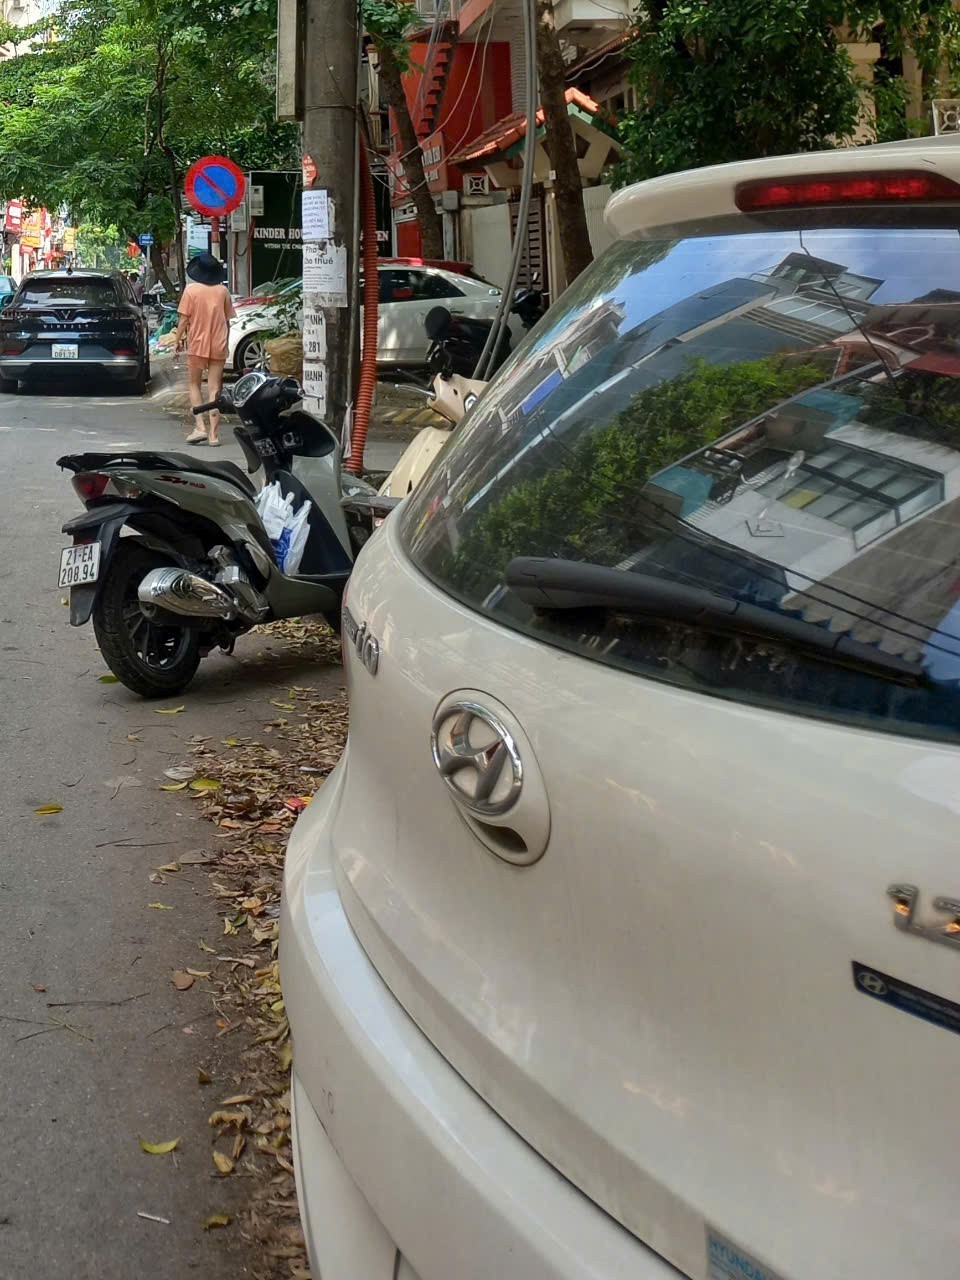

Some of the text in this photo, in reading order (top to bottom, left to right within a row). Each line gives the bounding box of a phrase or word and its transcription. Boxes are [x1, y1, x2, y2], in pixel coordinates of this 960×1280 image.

[253, 227, 286, 239] KINDER
[66, 545, 94, 566] 21-EA
[61, 562, 95, 585] 208.94
